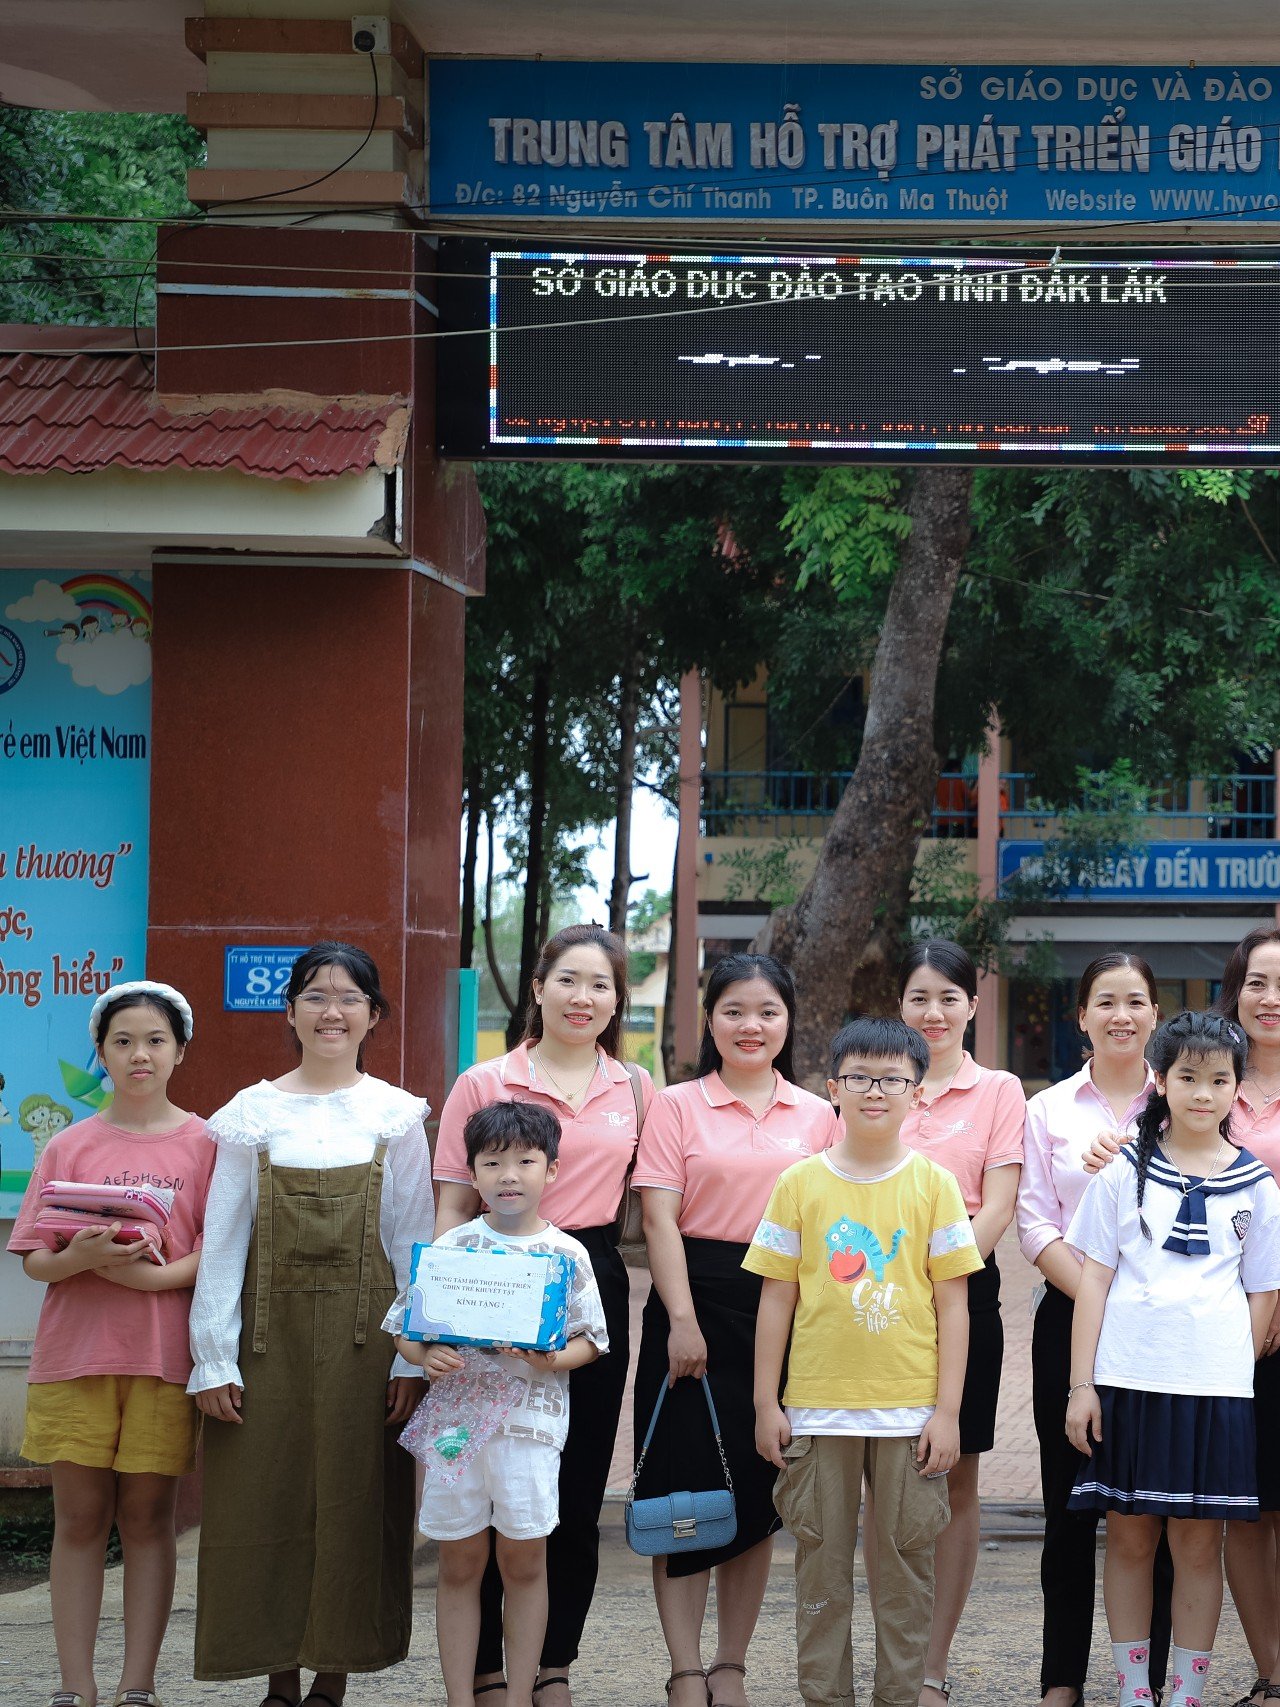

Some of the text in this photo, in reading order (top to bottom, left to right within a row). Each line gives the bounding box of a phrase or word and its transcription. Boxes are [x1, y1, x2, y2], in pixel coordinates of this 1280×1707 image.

[920, 68, 963, 100] SỞ
[981, 69, 1063, 101] GIÁO
[1078, 77, 1138, 106] DỤC
[1153, 70, 1192, 101] VÀ
[1204, 71, 1273, 102] ĐÀO
[489, 117, 630, 169] TRUNG
[644, 112, 734, 170] TÂM
[751, 104, 805, 170] HỖ
[818, 119, 898, 182] TRỢ
[916, 114, 1022, 173] PHÁT
[1032, 106, 1150, 174] TRIỂN
[1169, 116, 1262, 174] GIÁO
[455, 181, 503, 208] Đ/c:
[512, 184, 541, 208] 82
[550, 179, 638, 214] Nguyễn
[647, 183, 692, 210] Chí
[702, 185, 772, 210] Thanh
[792, 187, 825, 211] TP.
[832, 185, 889, 211] Buôn
[900, 188, 935, 212] Ma
[947, 187, 1009, 217] Thuột
[1046, 188, 1137, 212] Website
[532, 258, 585, 296] SỞ
[594, 261, 677, 297] GIÁO
[687, 269, 757, 306] DỤC
[767, 263, 843, 300] ĐÀO
[854, 272, 923, 307] TẠO
[20, 733, 51, 759] em
[55, 724, 98, 766] Việt
[101, 725, 147, 759] Nam
[1154, 847, 1209, 889] ĐẾN
[245, 966, 293, 996] 82
[234, 995, 266, 1007] NGUYỄN
[430, 1275, 452, 1283] TRUNG
[851, 1278, 904, 1311] Cat
[456, 1297, 477, 1307] KÍNH
[866, 1311, 891, 1335] life
